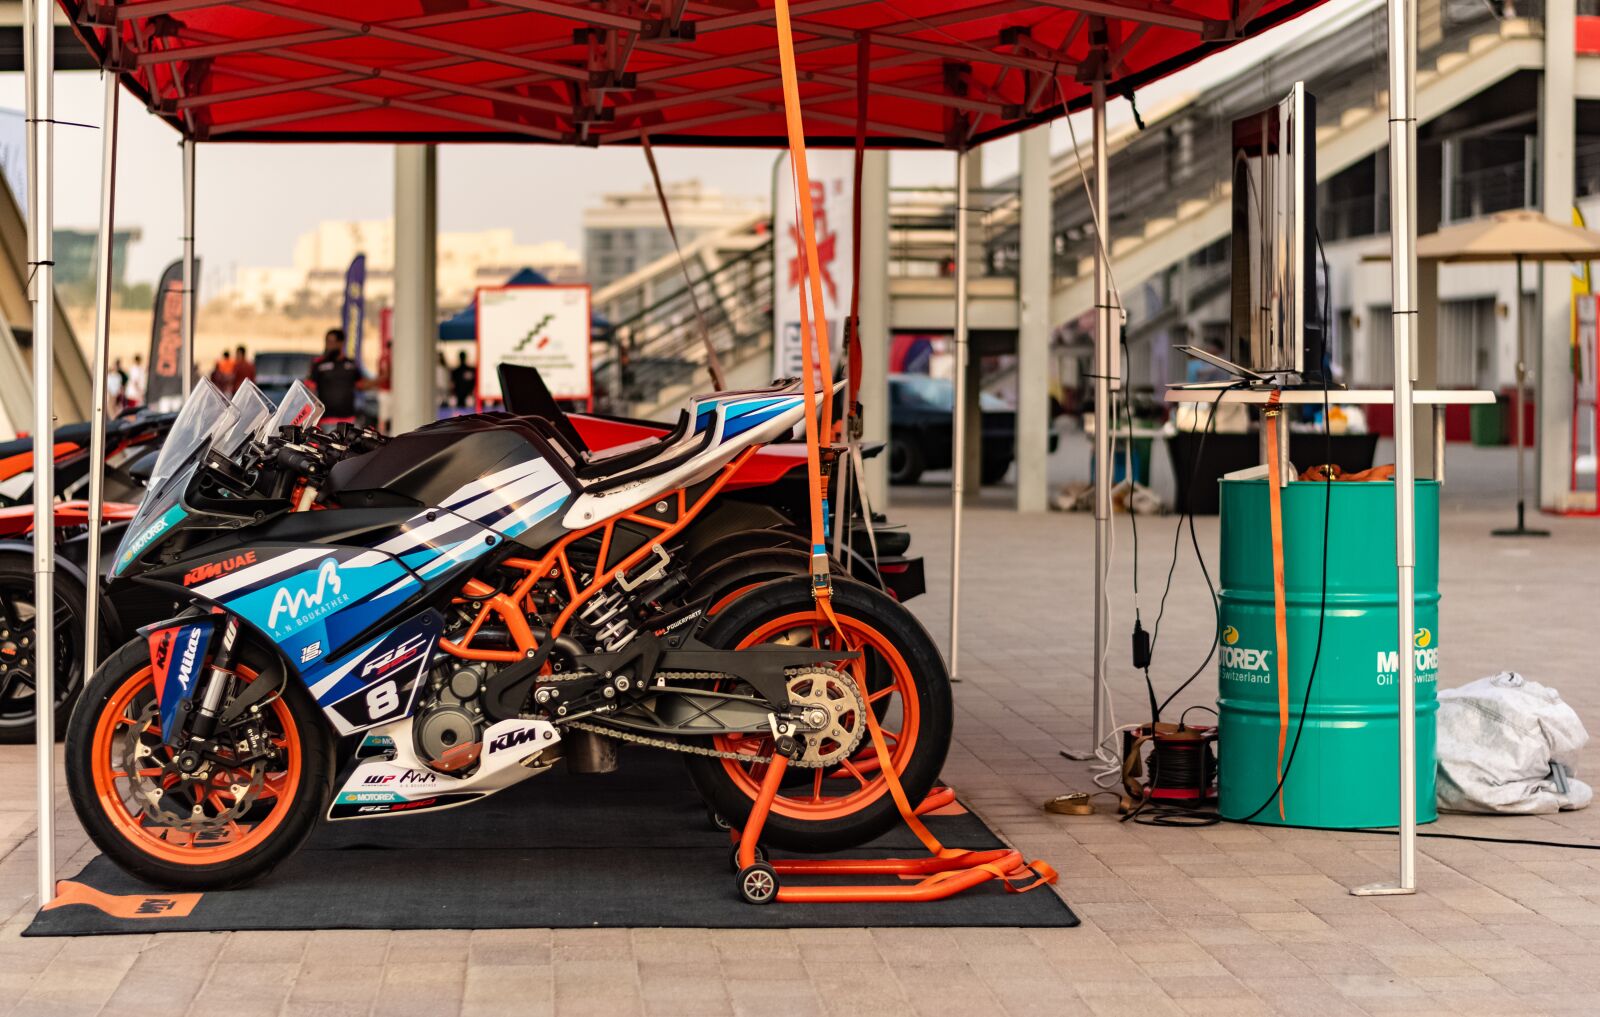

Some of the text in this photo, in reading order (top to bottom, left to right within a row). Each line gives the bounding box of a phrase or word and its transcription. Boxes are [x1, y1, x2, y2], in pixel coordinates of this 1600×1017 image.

[132, 516, 169, 554] MOTOREX
[184, 551, 257, 587] KTM UAE
[178, 627, 201, 691] Mitas
[361, 632, 427, 678] RC
[1377, 674, 1393, 686] Oil
[366, 680, 400, 720] 8
[488, 727, 536, 755] KTM
[364, 775, 397, 784] WP
[357, 793, 396, 801] MOTOREX
[134, 899, 177, 914] KTM
